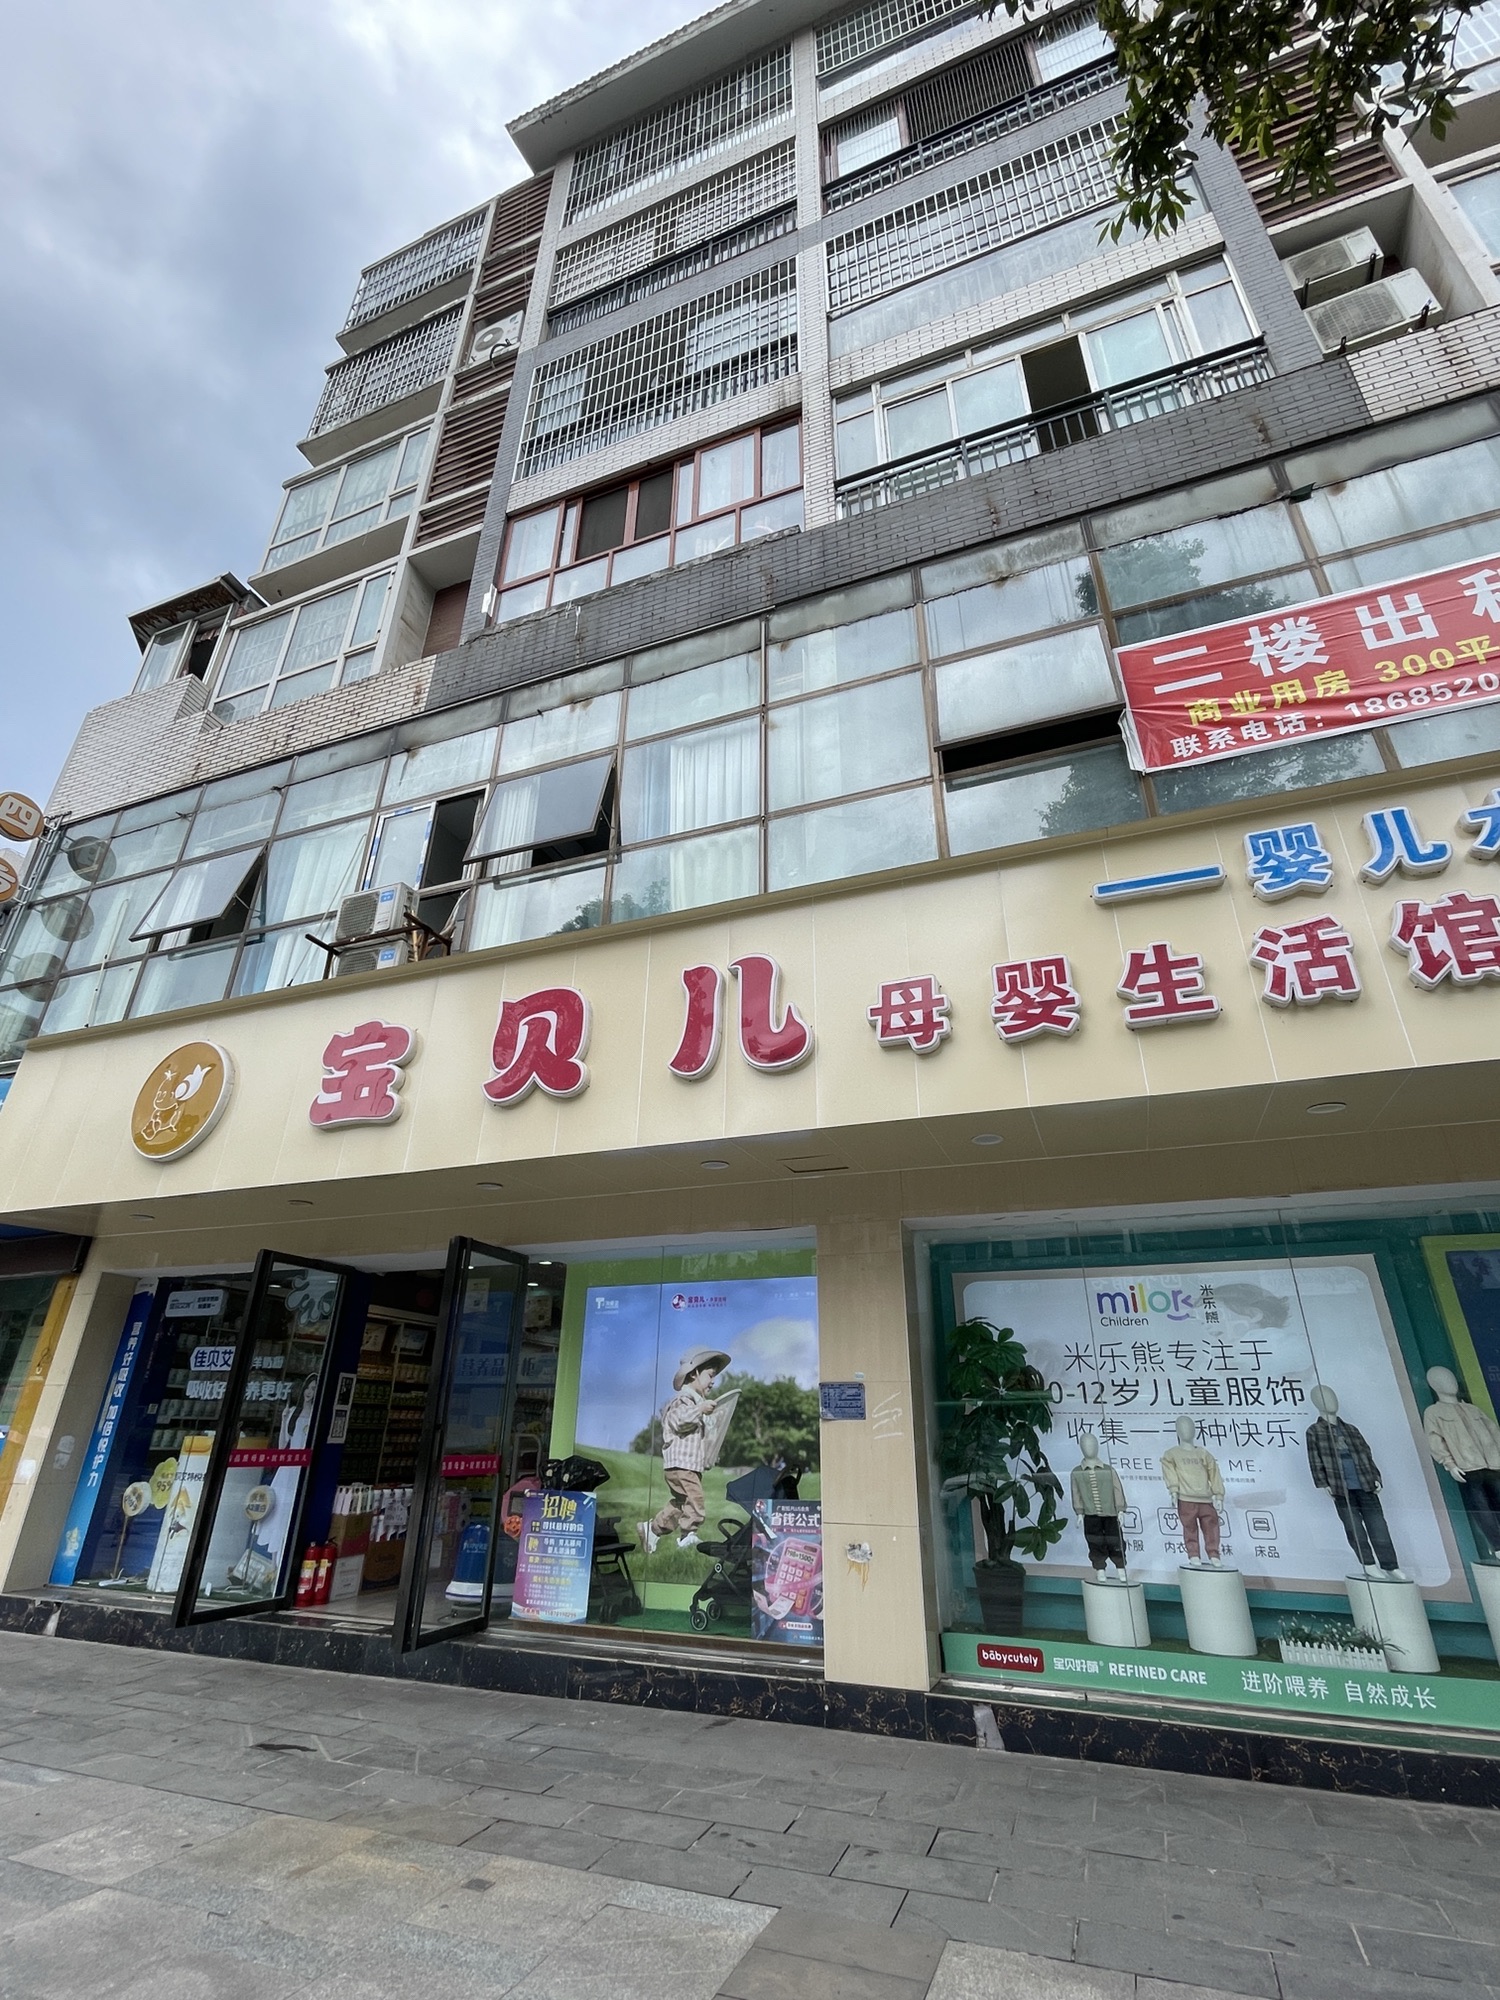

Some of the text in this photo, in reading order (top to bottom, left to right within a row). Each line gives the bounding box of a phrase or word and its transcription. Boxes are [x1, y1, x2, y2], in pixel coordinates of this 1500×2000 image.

[1184, 669, 1351, 727] 商业用房
[1344, 672, 1500, 719] 1868520
[309, 889, 1500, 1131] 宝贝儿 母婴生活馆
[1200, 1284, 1219, 1323] 米乐熊
[1100, 1317, 1149, 1327] Children
[1064, 1339, 1272, 1373] 米乐熊专注于
[1050, 1375, 1305, 1407] 0-12岁儿童服饰
[1110, 1457, 1263, 1473] FREE ME.
[540, 1493, 577, 1522] 招聘
[771, 1513, 821, 1527] 省钱公式
[1254, 1545, 1281, 1558] 床品
[1108, 1662, 1168, 1681] REFINED
[1169, 1668, 1208, 1686] CARE
[1241, 1670, 1437, 1709] 进阶喂养 自然成长
